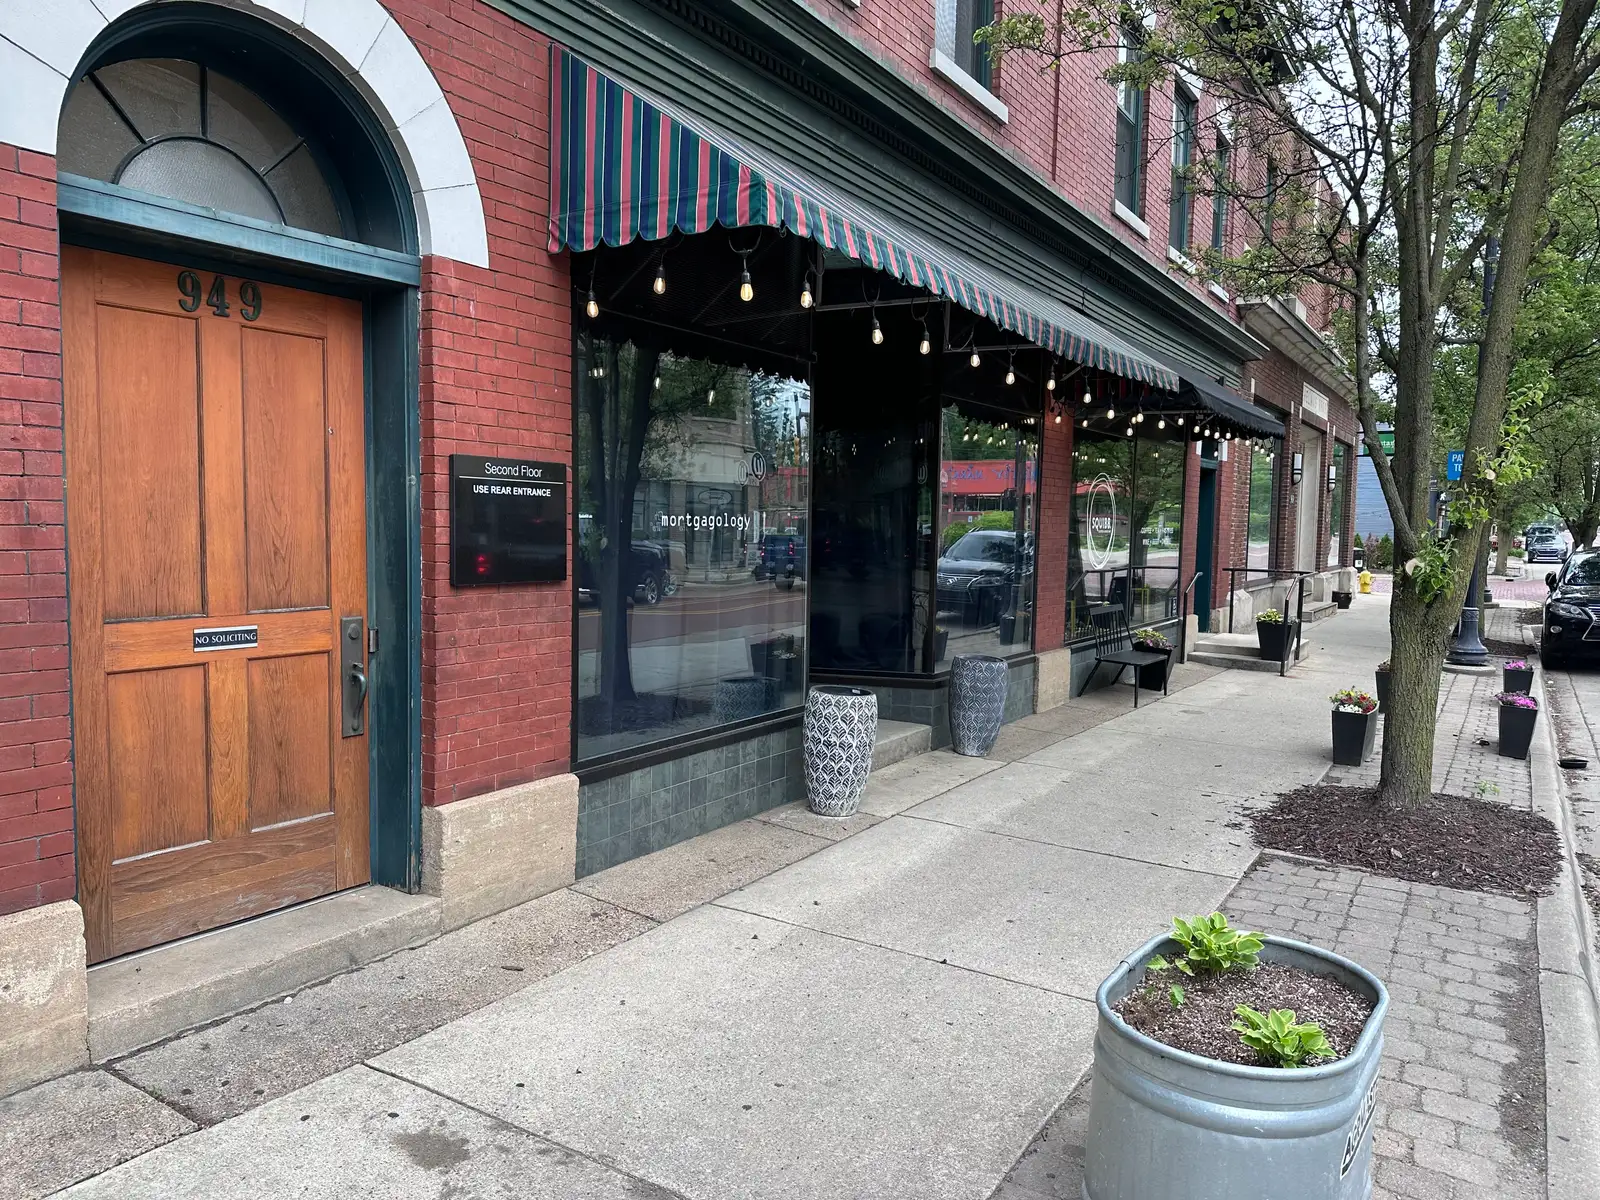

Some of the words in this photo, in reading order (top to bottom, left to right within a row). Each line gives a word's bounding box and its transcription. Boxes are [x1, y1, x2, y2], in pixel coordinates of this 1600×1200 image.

[178, 271, 262, 321] 949
[485, 462, 519, 476] Second
[521, 465, 542, 477] Floor
[473, 484, 489, 494] USE
[490, 485, 511, 495] REAR
[513, 487, 551, 497] ENTRANCE
[661, 513, 751, 531] mortgagology
[195, 635, 209, 644] NO
[211, 632, 257, 643] SOLICITING
